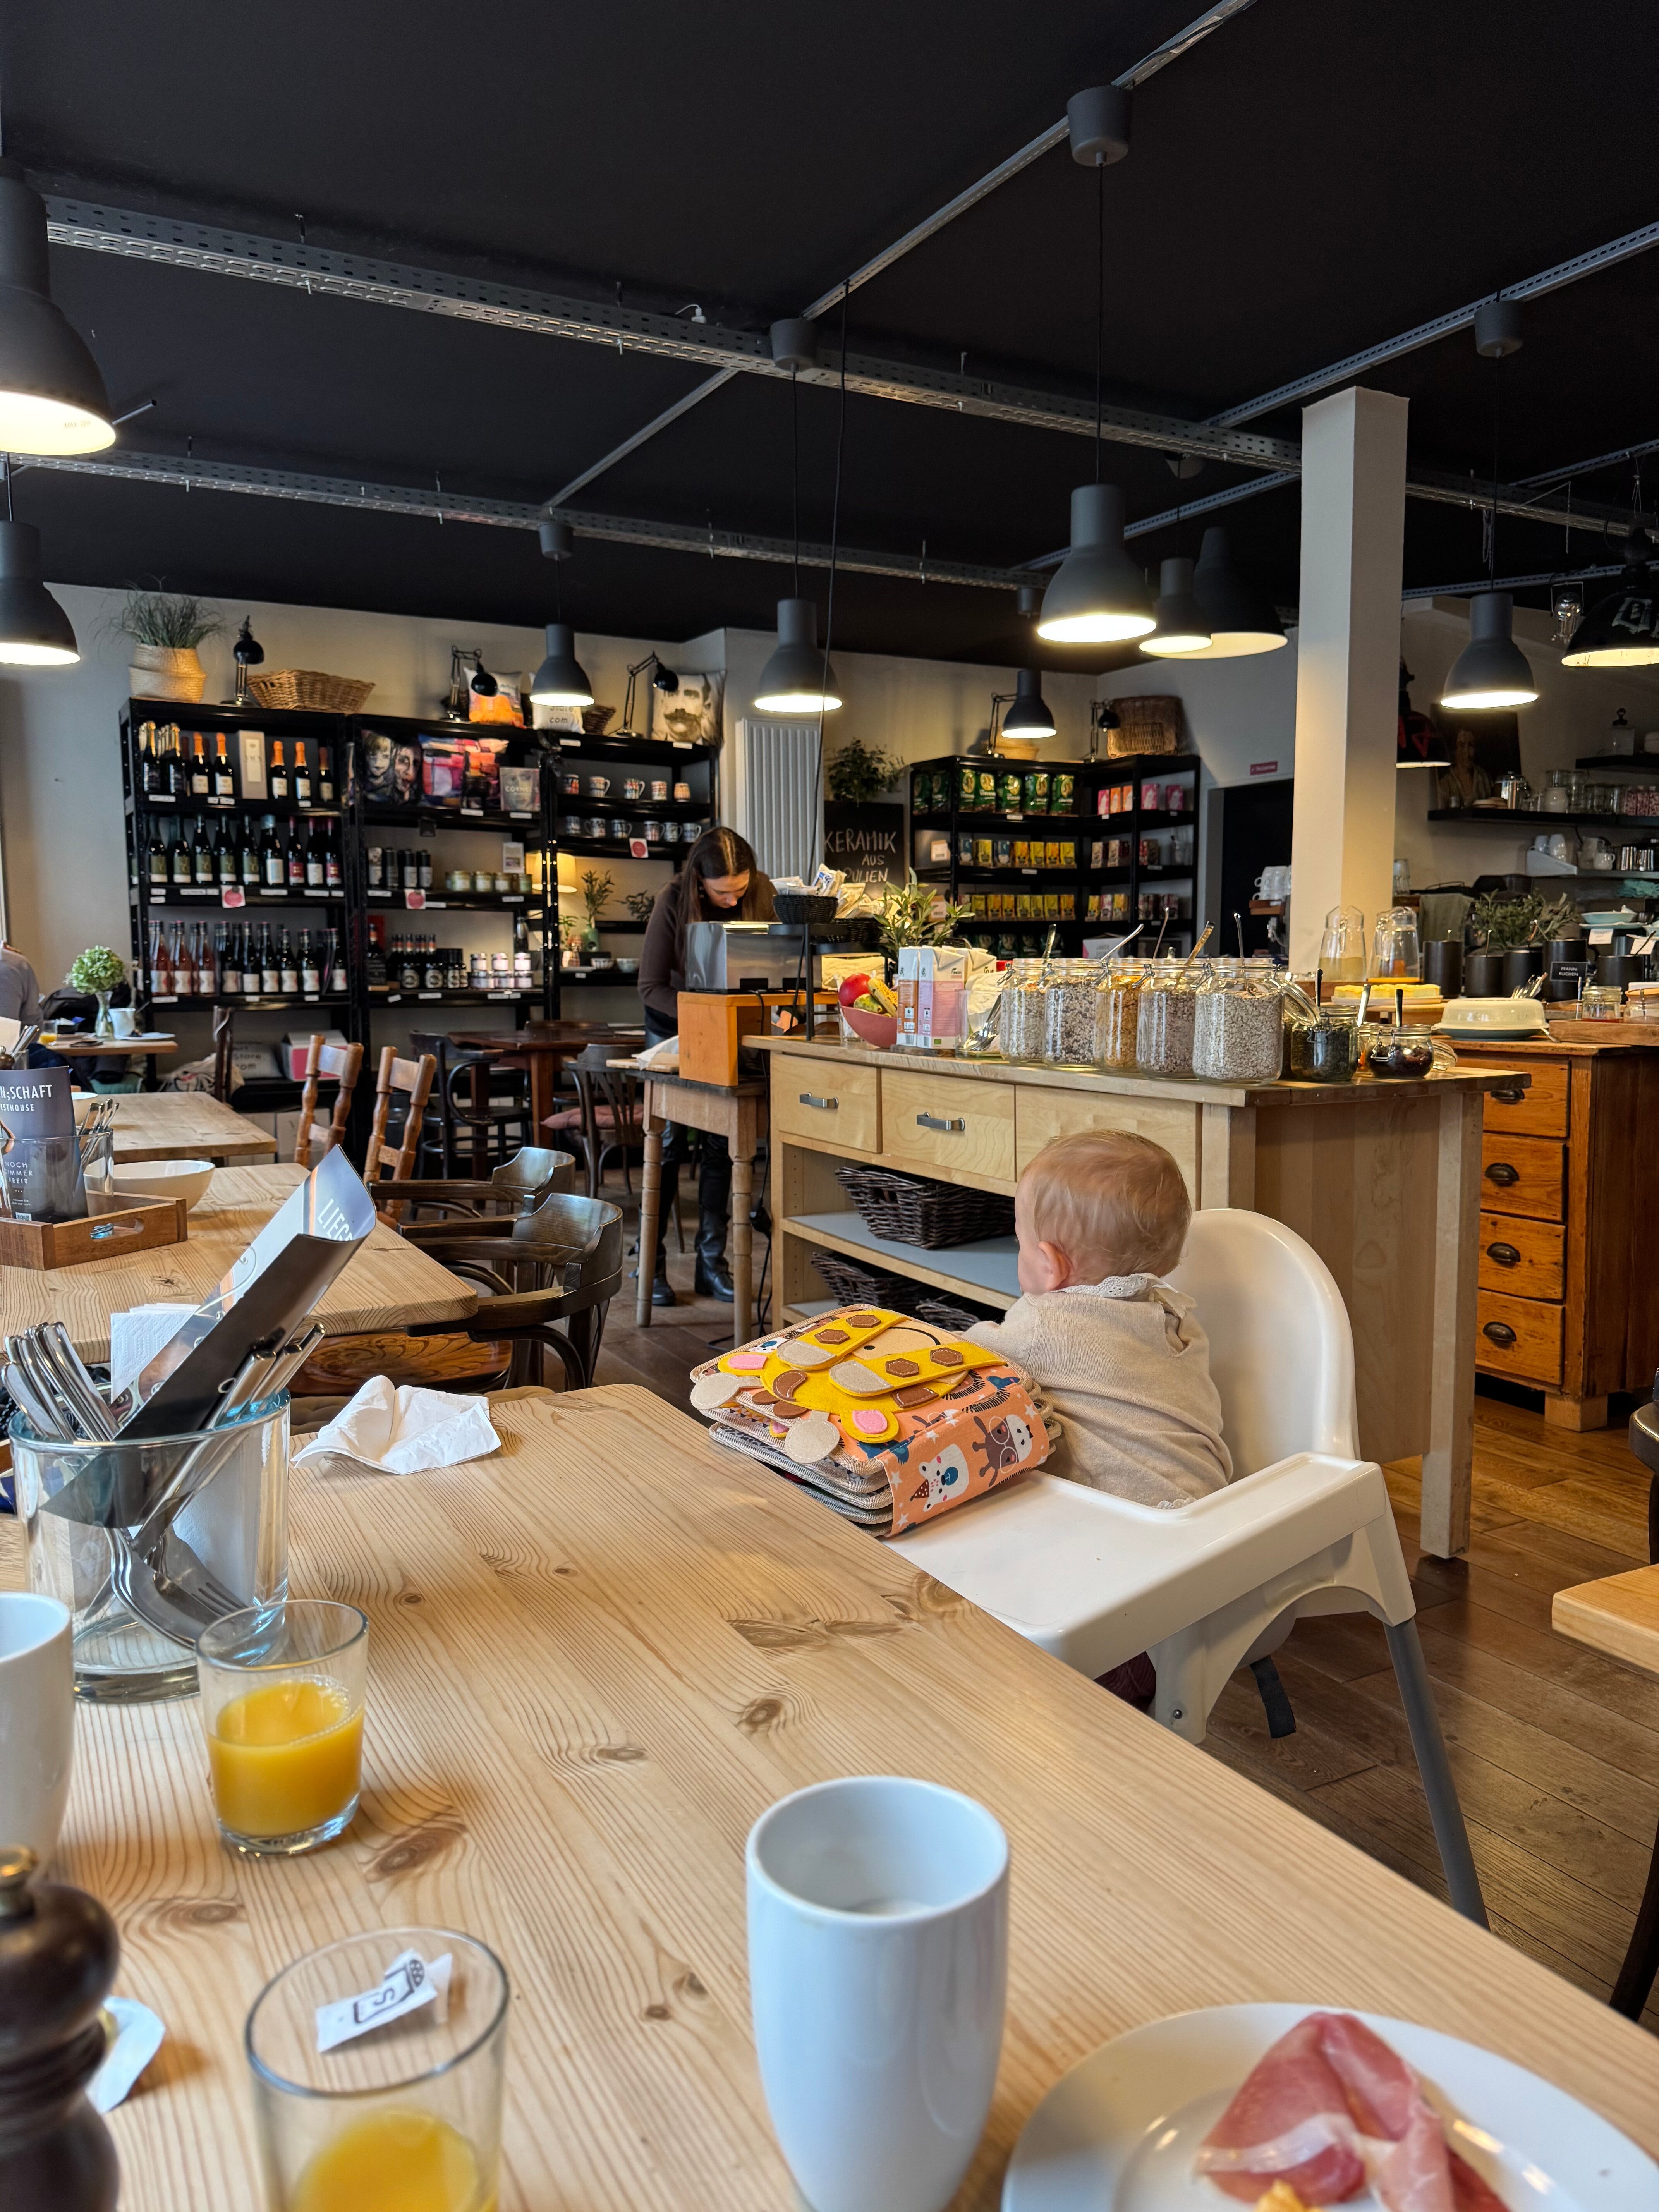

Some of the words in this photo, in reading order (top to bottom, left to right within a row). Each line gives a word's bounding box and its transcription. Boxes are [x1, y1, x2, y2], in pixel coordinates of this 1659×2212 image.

[824, 828, 896, 854] KERAMIK
[861, 854, 885, 866] AUS
[0, 1084, 52, 1101] N;SCHAFT
